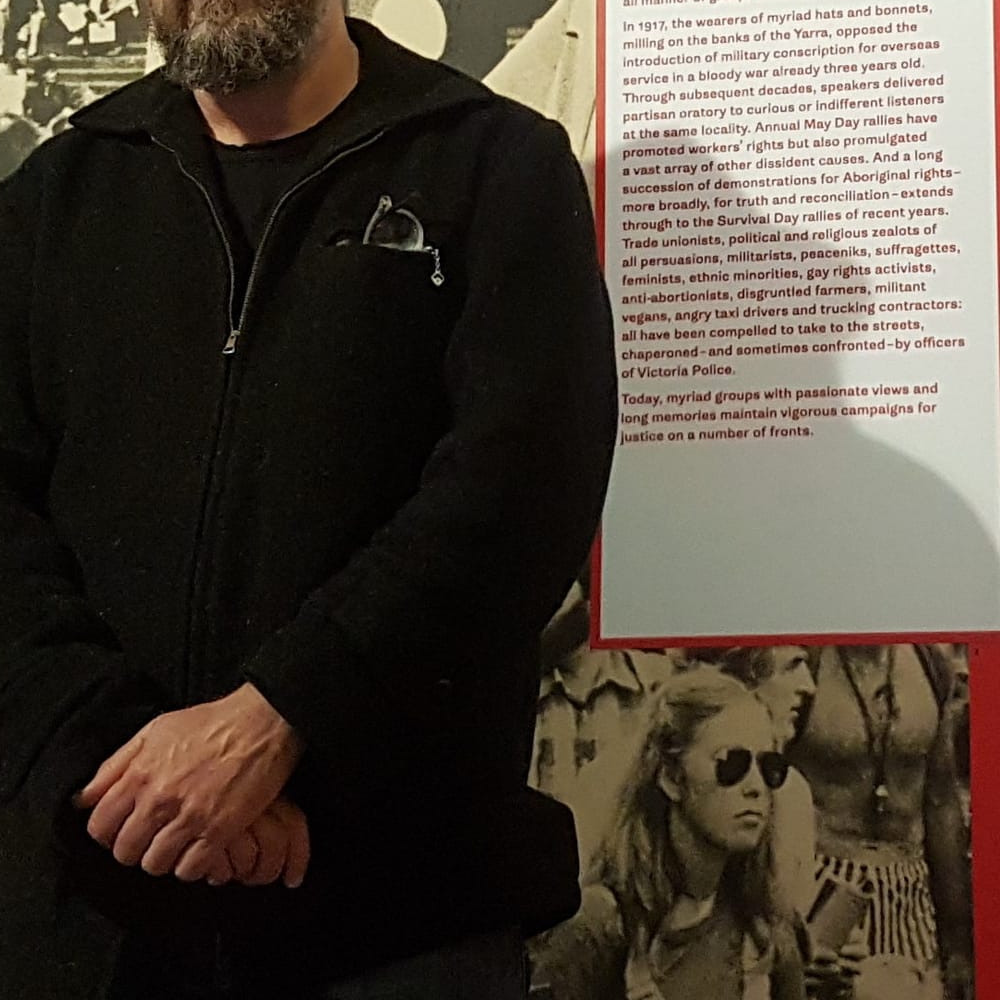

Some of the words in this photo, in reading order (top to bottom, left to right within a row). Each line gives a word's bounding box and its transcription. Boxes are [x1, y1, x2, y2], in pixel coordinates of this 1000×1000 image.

[623, 19, 634, 32] In
[638, 17, 667, 31] 1917,
[671, 16, 692, 29] the
[695, 15, 747, 27] wearers
[750, 11, 763, 24] of
[767, 8, 811, 26] myriad
[815, 8, 843, 20] hats
[847, 5, 871, 18] and
[875, 3, 932, 17] bonnets,
[623, 36, 664, 51] milling
[667, 37, 683, 47] on
[687, 33, 707, 46] the
[711, 31, 749, 44] banks
[753, 29, 766, 42] of
[770, 28, 790, 41] the
[793, 27, 832, 40] Yarra,
[836, 22, 892, 40] opposed
[896, 21, 917, 34] the
[623, 52, 701, 67] introduction
[704, 50, 718, 62] of
[721, 48, 770, 63] military
[773, 43, 854, 59] conscription
[858, 42, 876, 54] for
[880, 40, 939, 53] overseas
[623, 71, 669, 85] service
[672, 70, 683, 82] in
[687, 72, 695, 81] a
[698, 67, 742, 82] bloody
[744, 68, 768, 78] war
[772, 62, 820, 78] already
[823, 61, 857, 74] three
[861, 60, 897, 75] years
[900, 56, 924, 69] old.
[622, 89, 675, 105] Through
[679, 85, 754, 101] subsequent
[758, 82, 816, 96] decades,
[820, 78, 879, 95] speakers
[883, 74, 943, 89] delivered
[623, 108, 675, 125] partisan
[679, 106, 726, 120] oratory
[729, 105, 743, 116] to
[746, 101, 795, 115] curious
[798, 102, 812, 112] or
[815, 97, 883, 111] indifferent
[887, 95, 944, 107] listeners
[622, 142, 684, 160] promoted
[688, 139, 743, 154] workers'
[746, 138, 784, 154] rights
[787, 137, 809, 149] but
[812, 135, 840, 148] also
[843, 130, 926, 149] promulgated
[622, 216, 672, 232] through
[676, 217, 689, 228] to
[692, 215, 714, 227] the
[717, 212, 770, 226] Survival
[774, 211, 799, 226] Day
[802, 209, 841, 222] rallies
[845, 208, 858, 220] of
[862, 207, 905, 220] recent
[908, 207, 948, 221] years.
[622, 236, 658, 249] Trade
[661, 233, 725, 247] unionists,
[728, 230, 780, 247] political
[784, 228, 809, 242] and
[812, 227, 868, 243] religious
[871, 224, 919, 238] zealots
[923, 223, 936, 235] of
[622, 254, 636, 267] all
[640, 252, 722, 270] persuasions,
[727, 249, 796, 263] militarists,
[800, 245, 871, 263] peaceniks,
[875, 243, 960, 258] suffragettes,
[622, 272, 685, 285] feminists,
[688, 269, 729, 283] ethnic
[733, 267, 802, 281] minorities,
[806, 268, 829, 281] gay
[833, 264, 871, 280] rights
[874, 262, 935, 275] activists,
[621, 288, 733, 304] anti-abortionists,
[736, 284, 811, 302] disgruntled
[815, 284, 871, 296] farmers,
[875, 281, 926, 294] militant
[621, 365, 634, 378] of
[637, 364, 688, 377] Victoria
[692, 363, 735, 376] Police.
[621, 392, 662, 407] Today,
[666, 390, 711, 406] myriad
[714, 391, 760, 405] groups
[763, 387, 791, 400] with
[795, 386, 868, 402] passionate
[871, 384, 909, 396] views
[913, 382, 937, 395] and
[620, 428, 664, 444] justice
[667, 430, 683, 440] on
[687, 430, 695, 439] a
[698, 426, 749, 439] number
[752, 425, 766, 437] of
[769, 425, 813, 437] fronts.
